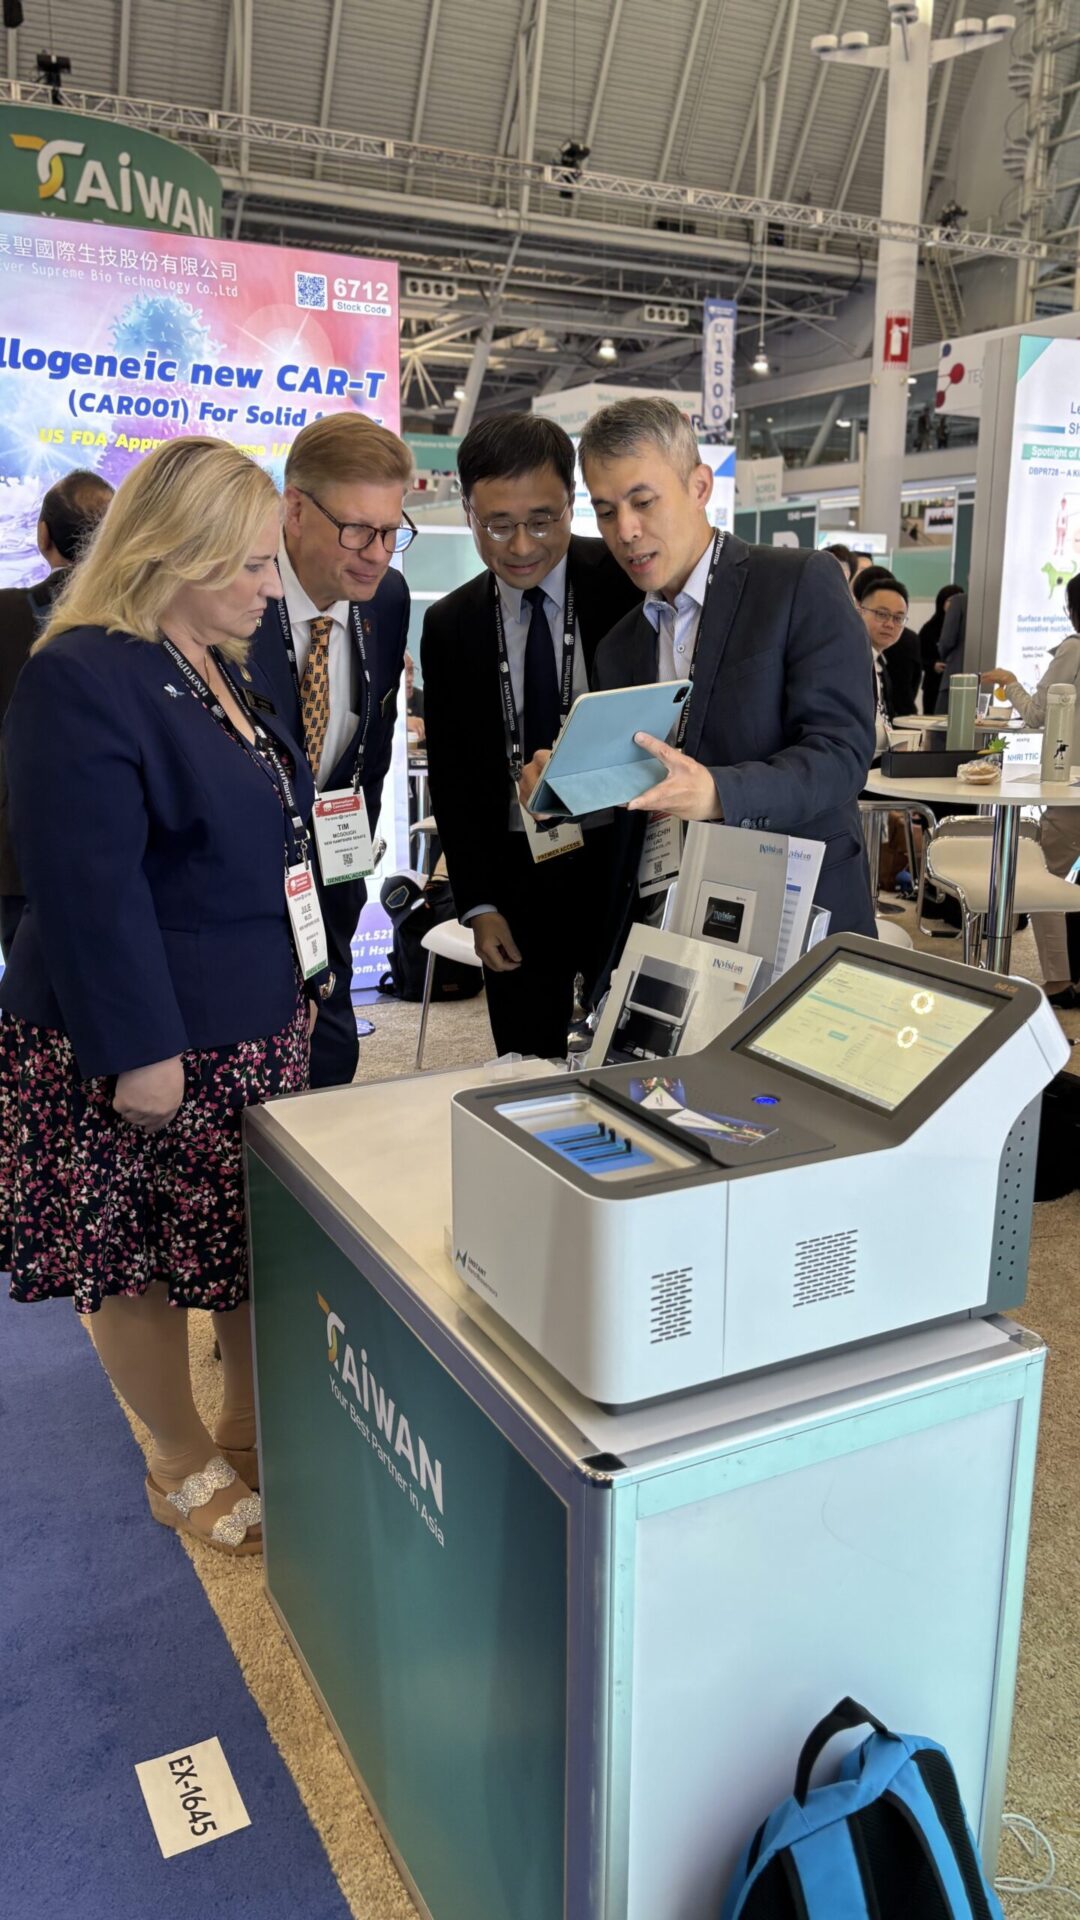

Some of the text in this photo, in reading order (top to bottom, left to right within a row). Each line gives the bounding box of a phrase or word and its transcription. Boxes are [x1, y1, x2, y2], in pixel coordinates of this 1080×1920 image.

[32, 262, 85, 280] Supreme
[91, 268, 112, 283] Bio
[118, 272, 190, 294] Technology
[333, 277, 389, 302] 6712
[337, 301, 387, 314] Stock Code
[191, 363, 263, 389] new
[276, 364, 386, 398] CAR-T
[68, 389, 189, 425] (CAR001)
[199, 402, 238, 422] For
[245, 405, 307, 427] Solid
[39, 428, 64, 444] US
[70, 430, 108, 447] FDA
[337, 822, 350, 831] TIM
[327, 869, 373, 883] GENERAL ACCESS
[329, 1374, 445, 1548] Your Best Partner in Asia
[168, 1754, 218, 1836] EX-1645
